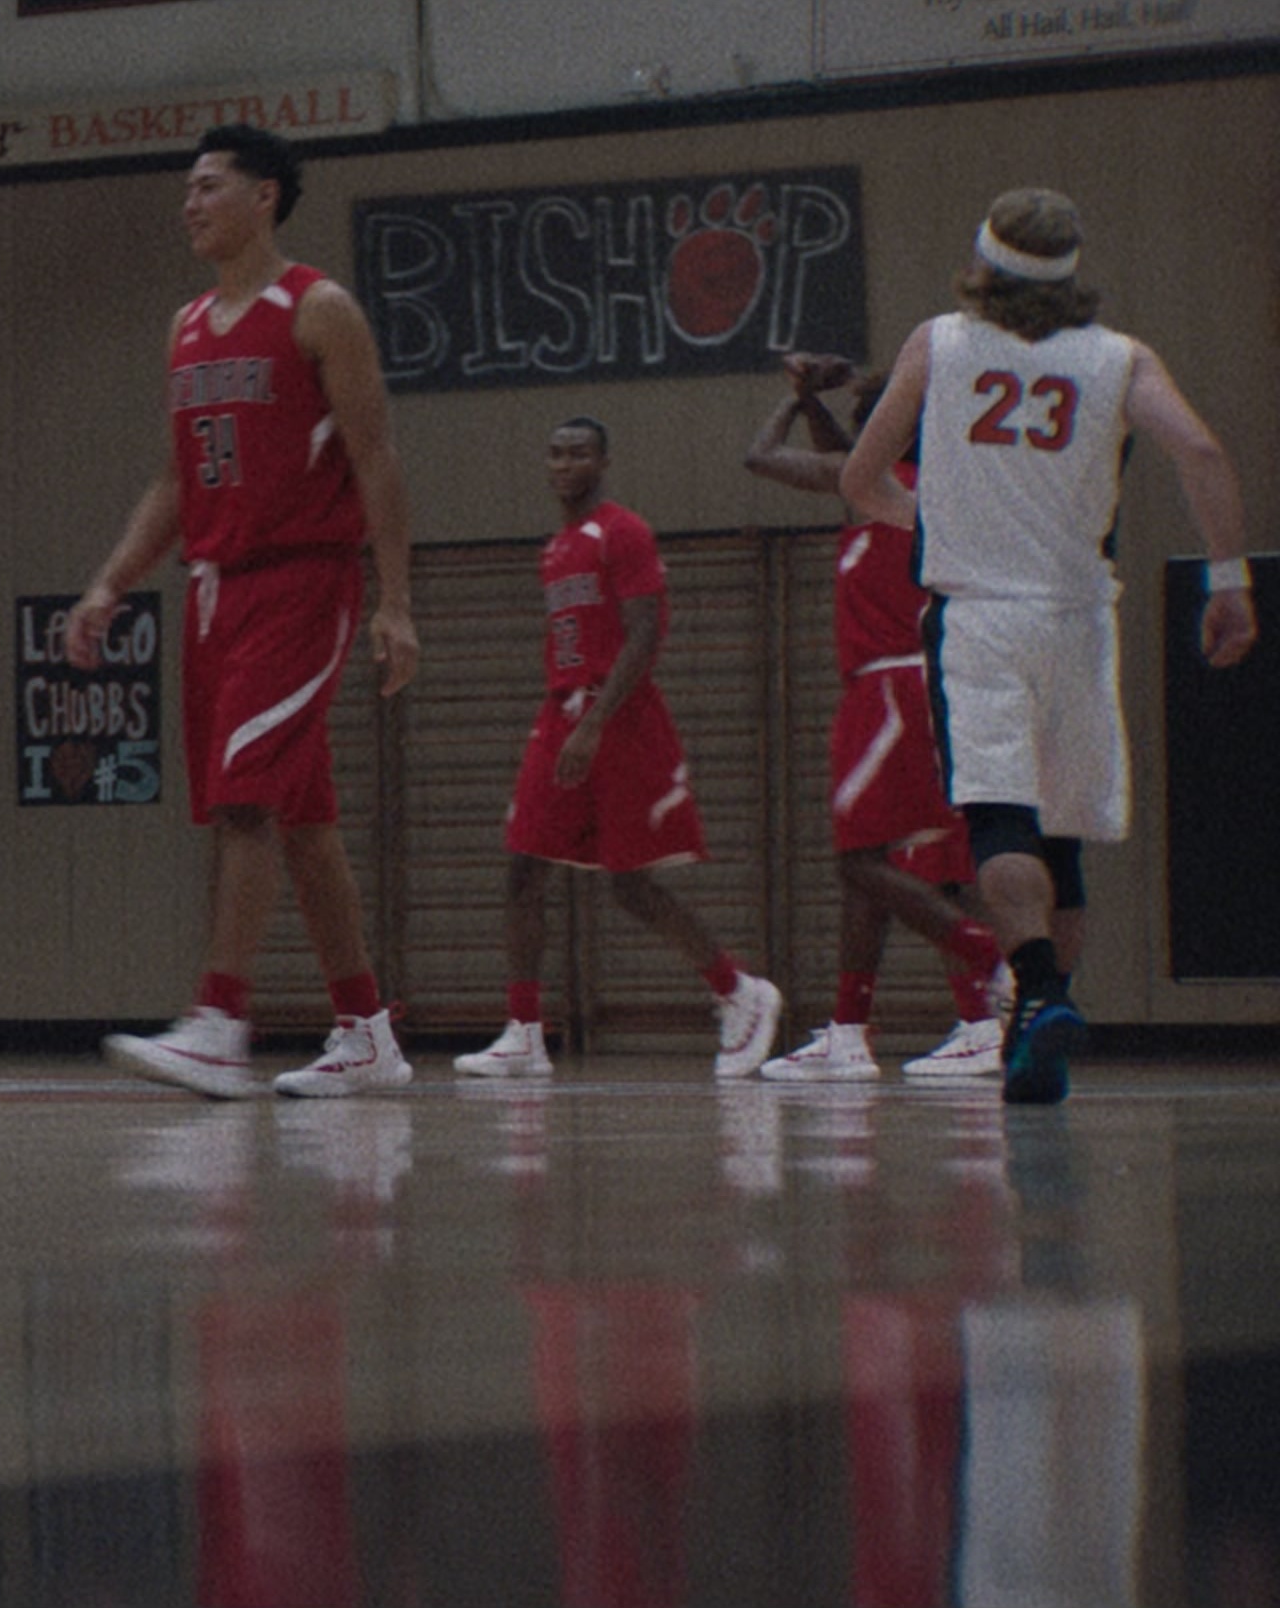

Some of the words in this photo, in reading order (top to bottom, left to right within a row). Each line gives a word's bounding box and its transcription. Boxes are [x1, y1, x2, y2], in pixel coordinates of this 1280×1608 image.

[48, 87, 367, 150] BASKETBALL
[968, 369, 1079, 451] 23
[23, 675, 152, 739] CHUBBS
[23, 744, 53, 799] I
[93, 739, 161, 802] #5
